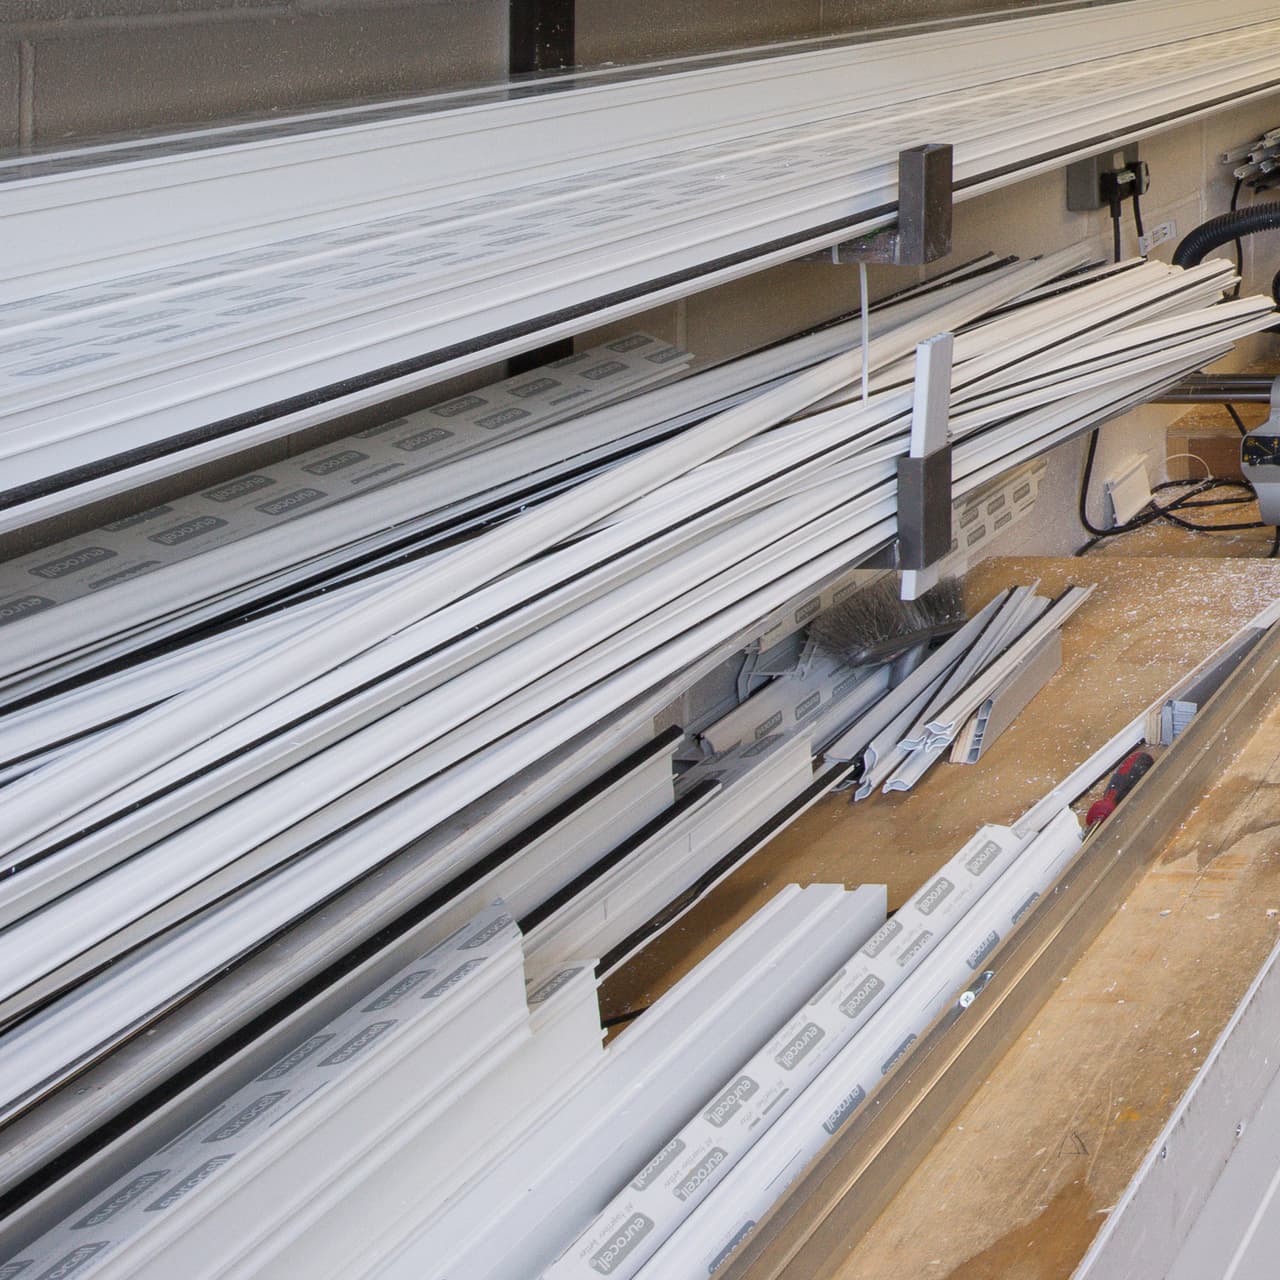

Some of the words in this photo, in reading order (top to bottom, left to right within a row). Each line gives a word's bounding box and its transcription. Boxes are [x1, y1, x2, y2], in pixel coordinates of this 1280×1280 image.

[161, 517, 219, 543] eurocell
[43, 547, 107, 577] eurocell
[847, 976, 880, 1016] eurocell
[782, 1025, 820, 1067] eurocell
[214, 1093, 284, 1141] eurocell
[706, 1077, 754, 1125] eurocell
[679, 1149, 727, 1199] eurocell
[86, 1171, 157, 1226] eurocell
[596, 1215, 647, 1272] eurocell
